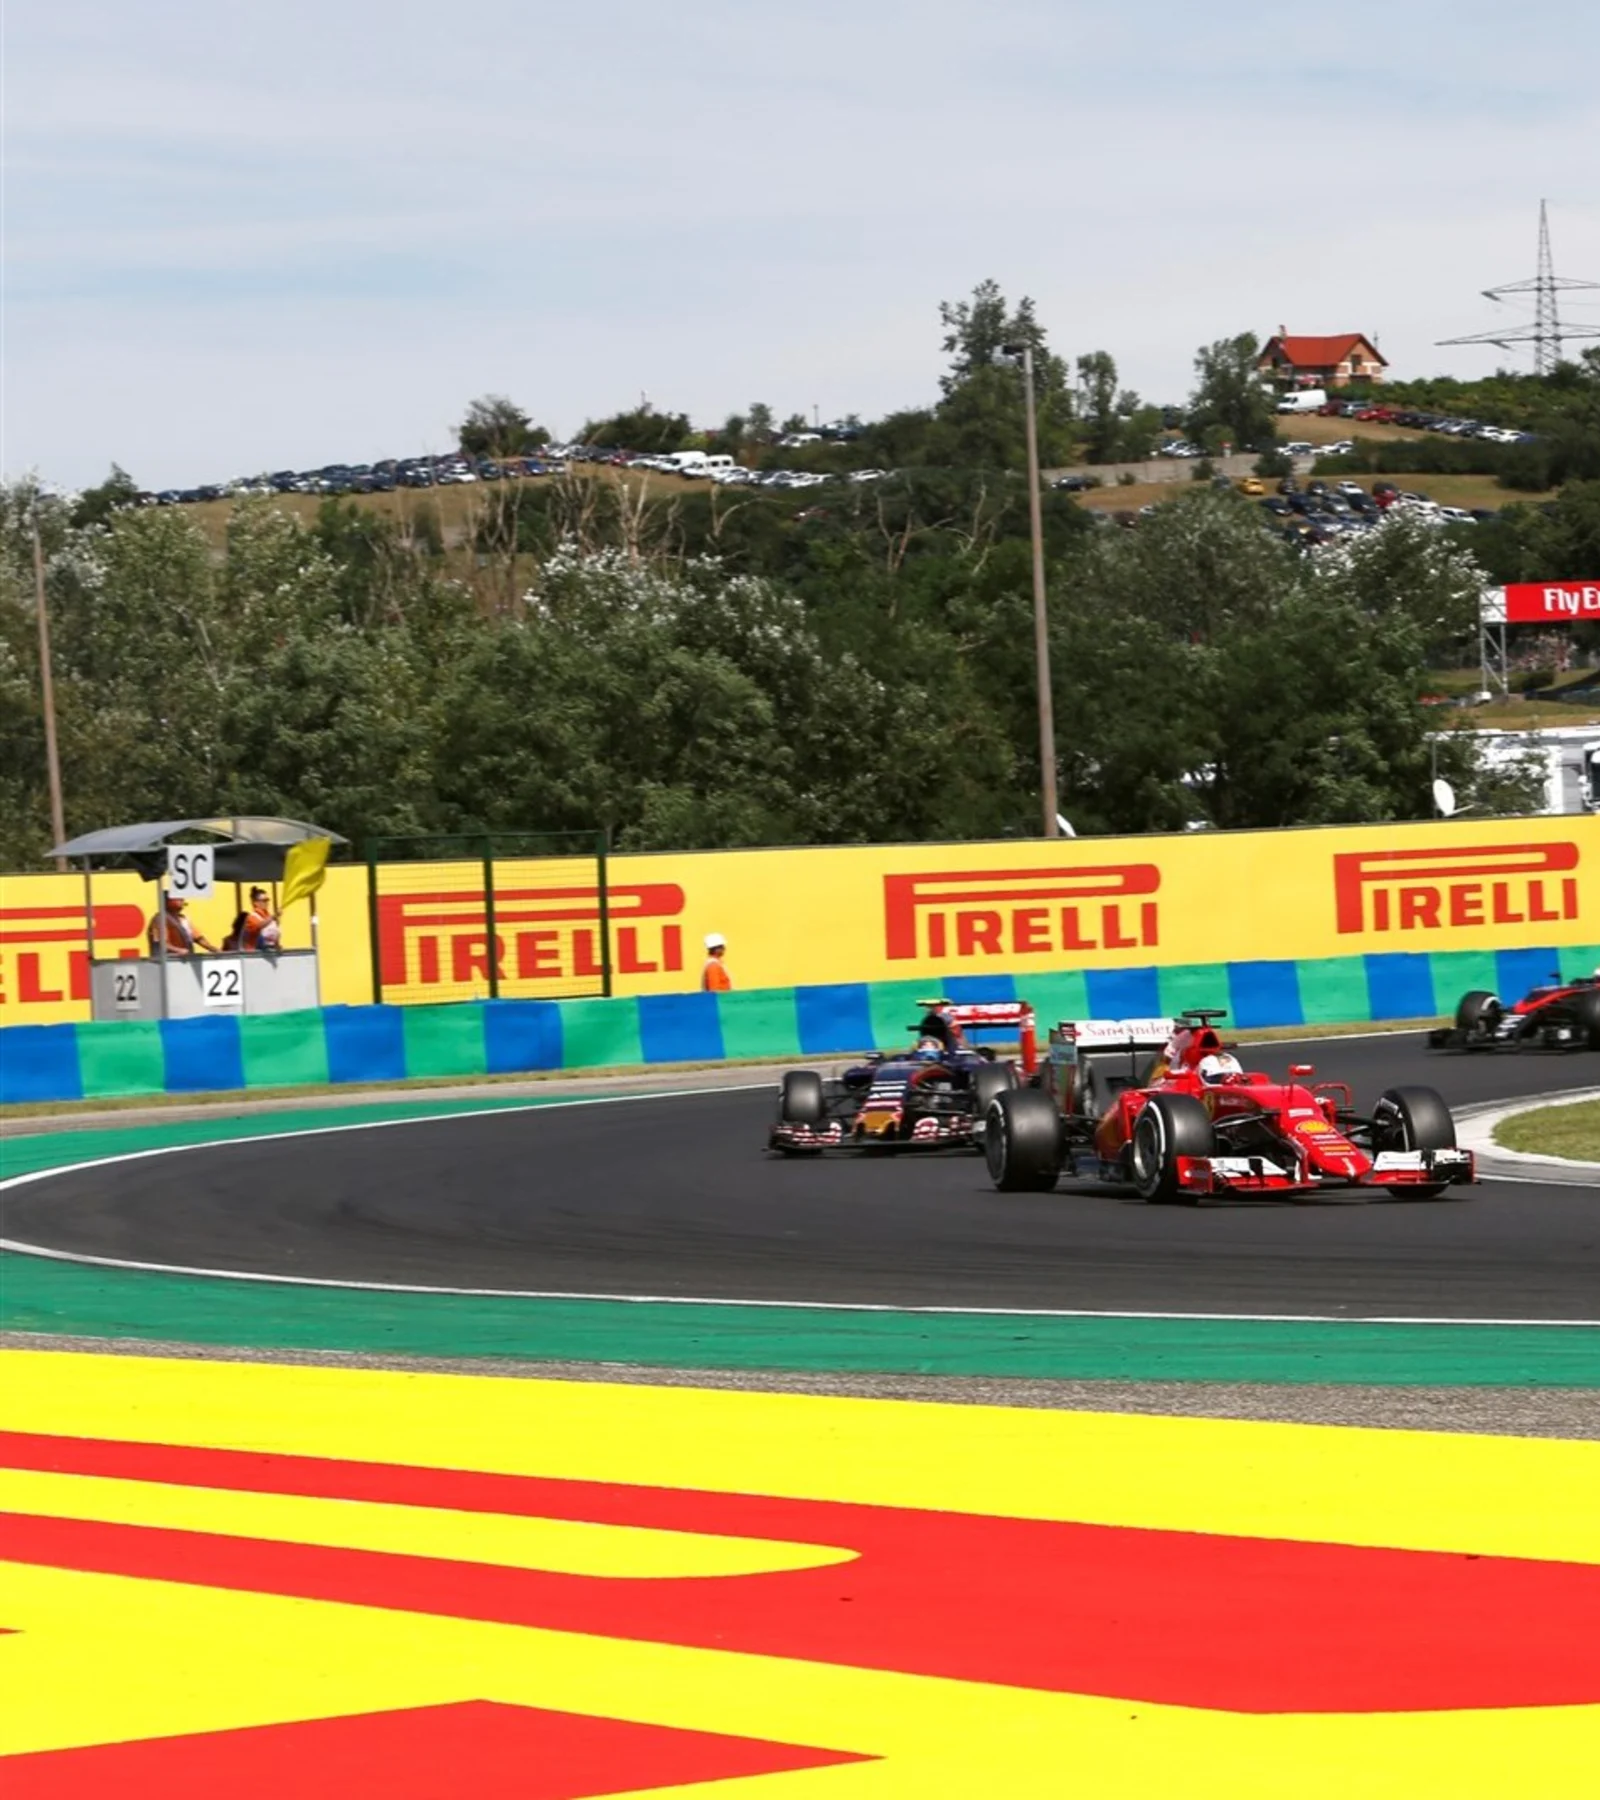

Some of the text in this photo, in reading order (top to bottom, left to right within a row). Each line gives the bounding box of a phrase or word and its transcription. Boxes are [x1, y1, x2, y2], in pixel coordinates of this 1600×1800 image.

[1543, 588, 1580, 614] Fly
[173, 853, 208, 889] SC
[1333, 841, 1580, 934] PIRELLI
[883, 863, 1161, 960] PIRELLI
[377, 883, 685, 985] PIRELLI
[115, 974, 137, 1001] 22
[207, 969, 240, 997] 22
[1086, 1021, 1173, 1038] Santander
